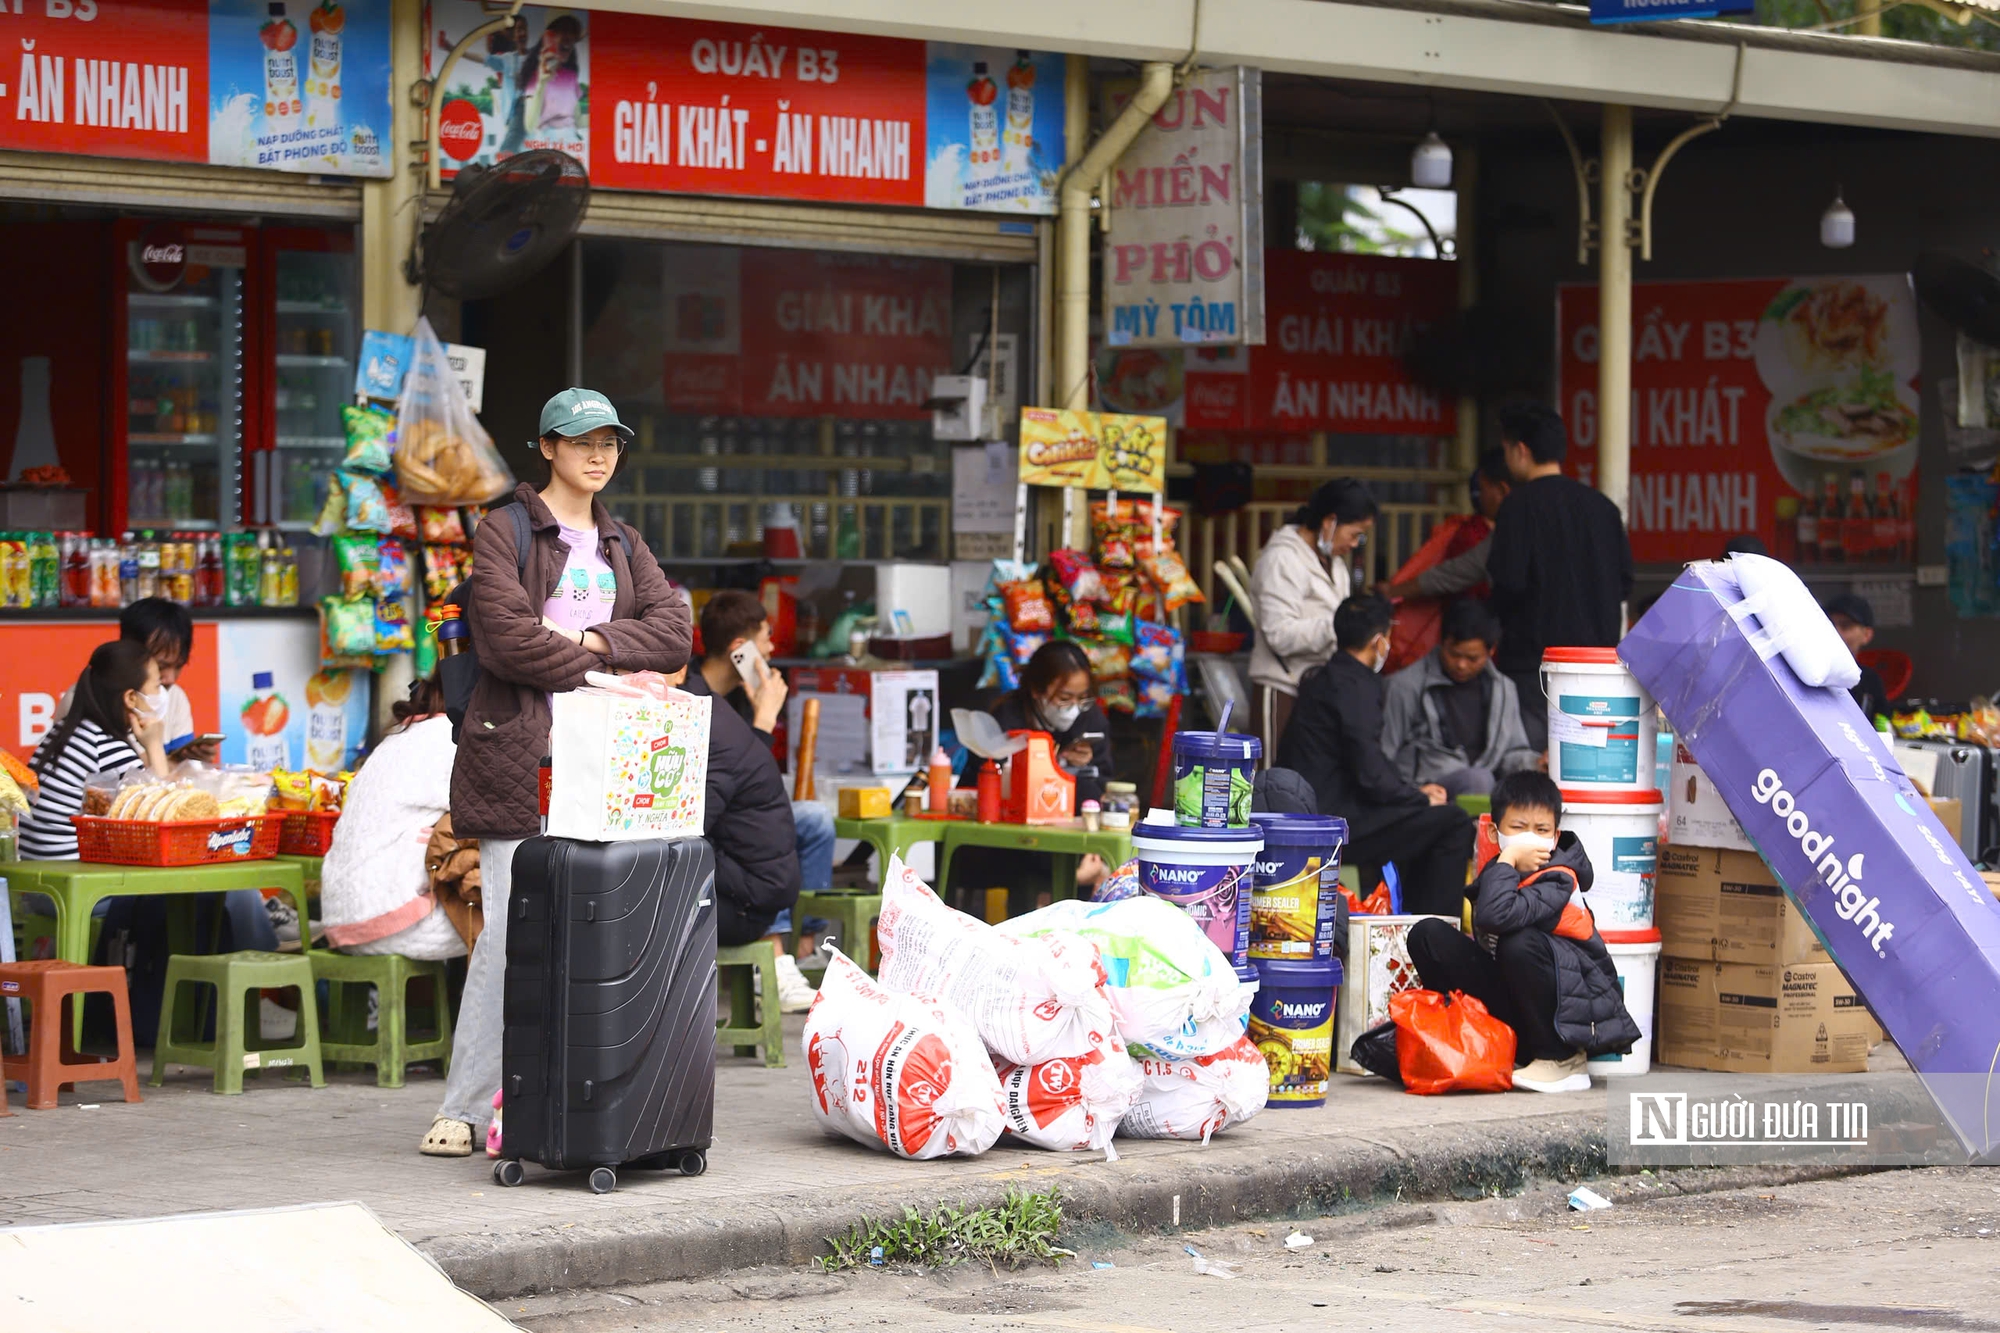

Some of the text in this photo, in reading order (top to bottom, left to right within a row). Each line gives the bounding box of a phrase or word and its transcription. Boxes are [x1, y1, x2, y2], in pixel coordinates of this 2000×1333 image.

[17, 38, 64, 123] ĂN
[75, 58, 188, 133] NHANH
[797, 47, 840, 84] B3
[614, 81, 671, 166] GIẢI
[678, 95, 749, 171] KHÁT
[772, 98, 812, 175] ĂN
[819, 115, 911, 181] NHANH
[284, 145, 329, 160] PHONG
[1114, 146, 1232, 208] MIẾN
[1114, 224, 1234, 284] PHỞ
[1170, 295, 1236, 336] TÔM
[1704, 319, 1757, 360] B3
[1273, 371, 1319, 418] ĂN
[1650, 375, 1747, 448] KHÁT
[1631, 472, 1757, 533] NHANH
[1671, 852, 1699, 863] Castrol
[1751, 768, 1895, 952] goodnight
[1917, 824, 1954, 866] Sống
[1159, 868, 1199, 883] NANO
[1255, 861, 1277, 874] NO
[1273, 897, 1300, 909] SEALER
[1782, 982, 1818, 991] MAGNATEC
[1793, 972, 1817, 980] Castrol
[1283, 1003, 1321, 1016] NANO
[853, 1059, 867, 1103] 212
[1155, 1061, 1172, 1076] 1.5
